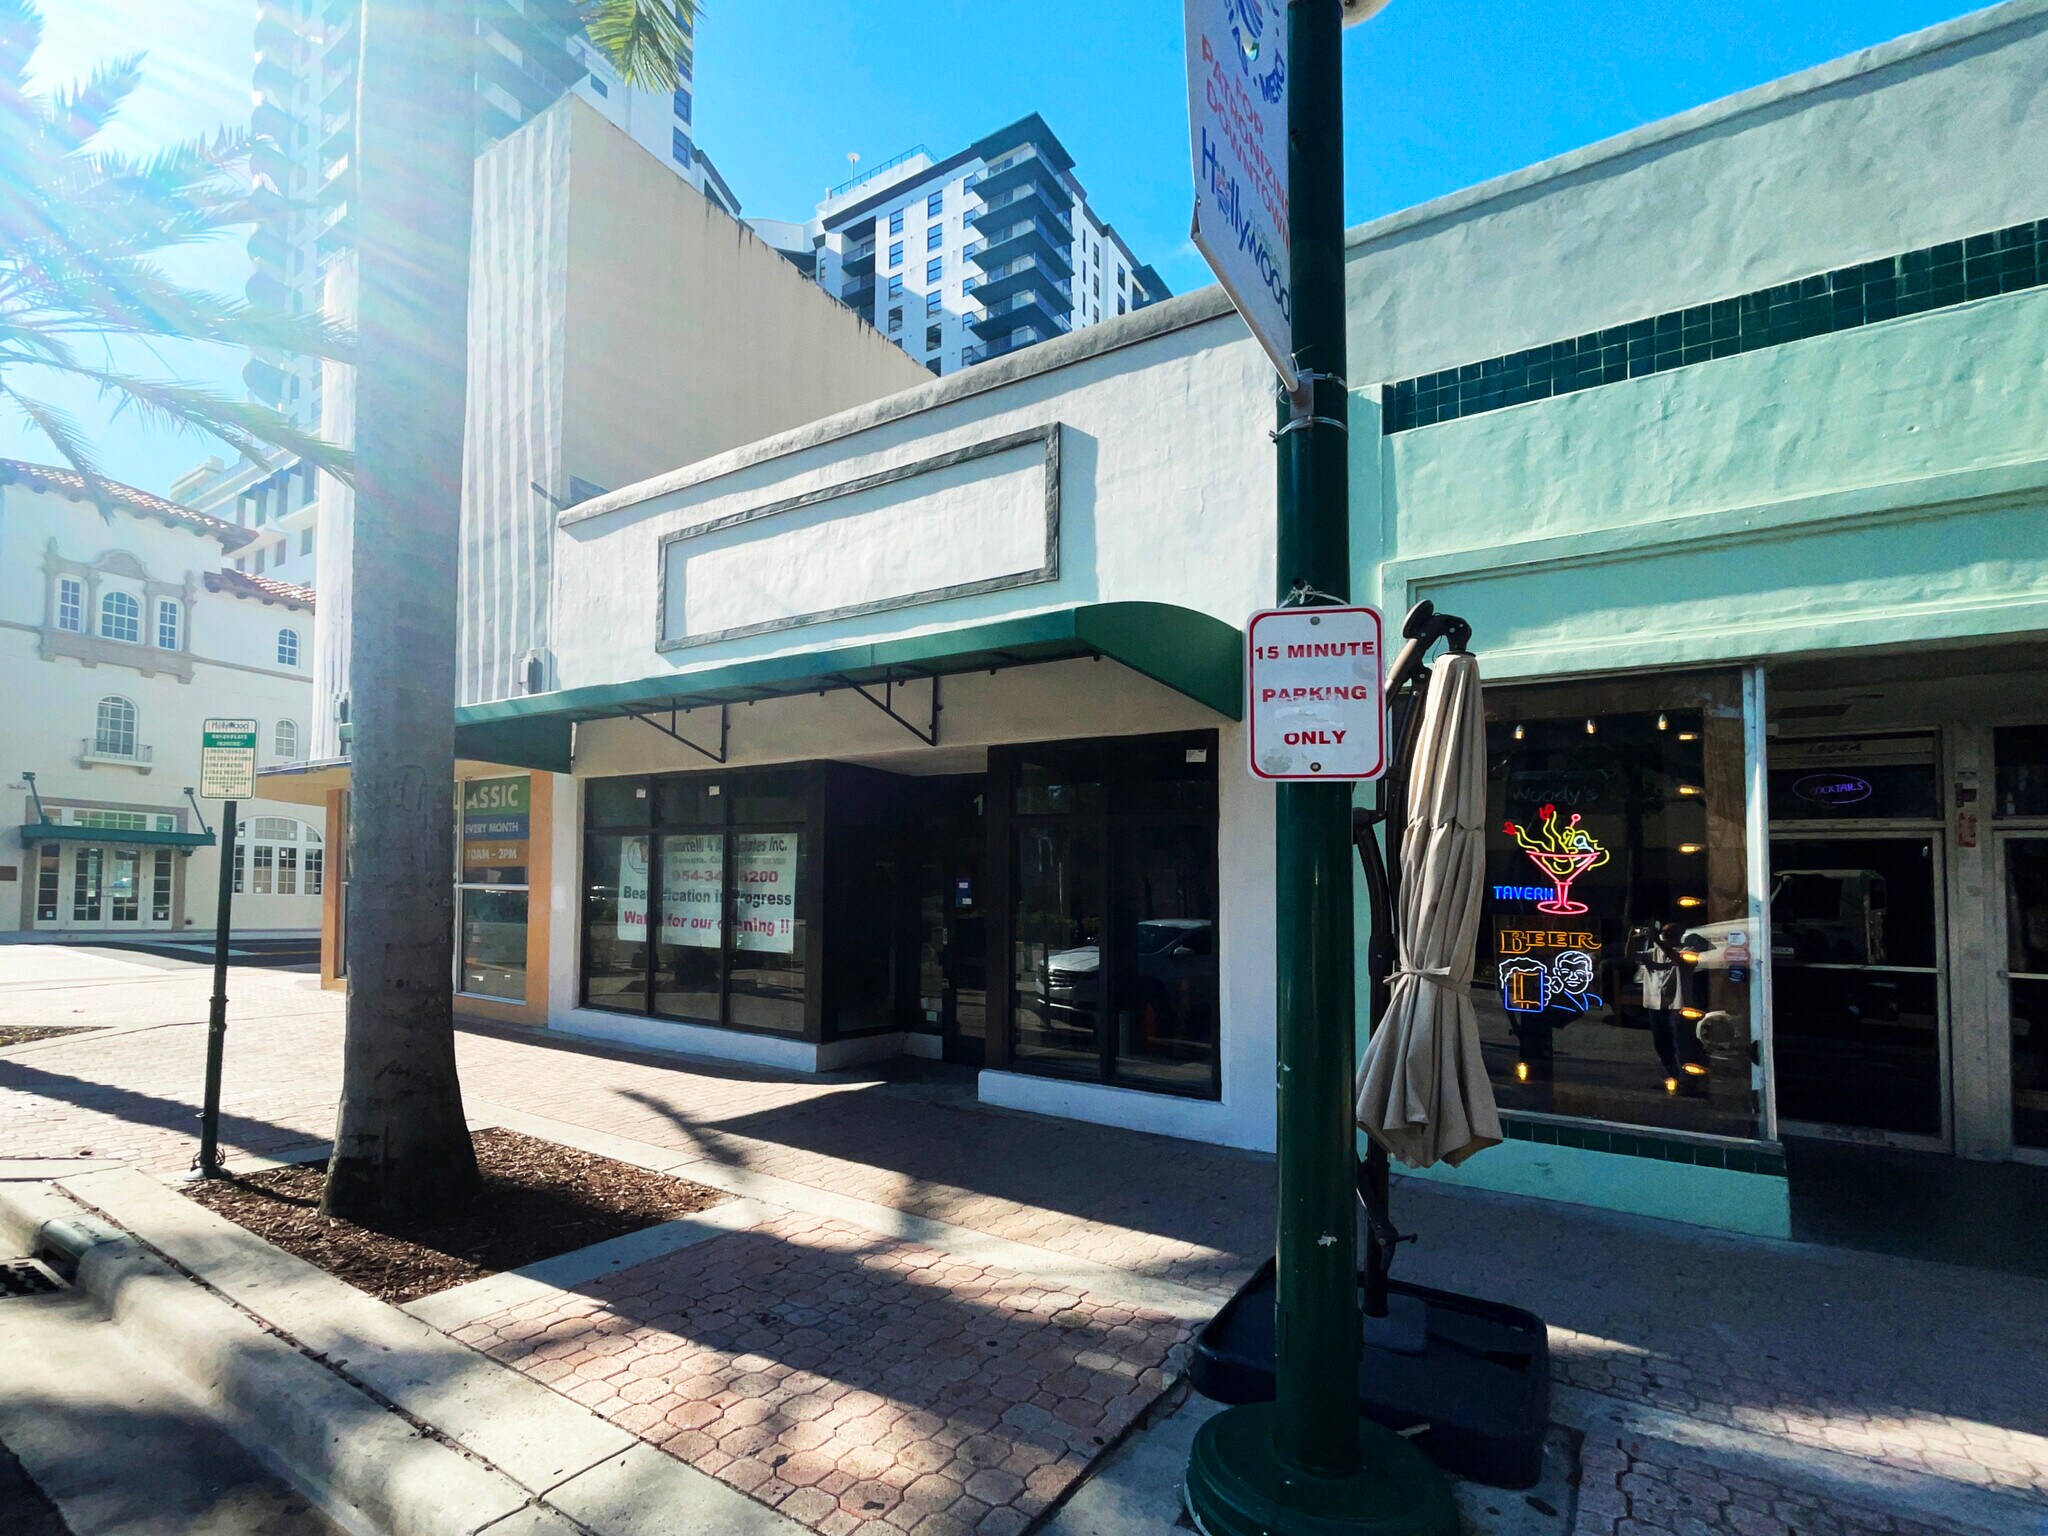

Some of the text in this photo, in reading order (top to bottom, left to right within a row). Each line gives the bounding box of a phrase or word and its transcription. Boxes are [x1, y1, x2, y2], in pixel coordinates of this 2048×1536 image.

[1236, 74, 1264, 143] FOR
[1255, 641, 1375, 660] 15 MINUTE
[1262, 685, 1367, 703] PARKING
[1283, 730, 1347, 746] ONLY
[465, 823, 487, 834] EVERY
[489, 822, 519, 833] MONTH
[769, 836, 788, 851] Inc.
[498, 848, 517, 859] 2PM
[1493, 886, 1554, 900] TAVERN
[667, 913, 688, 928] for
[691, 916, 713, 929] our
[1499, 930, 1602, 954] BEER
